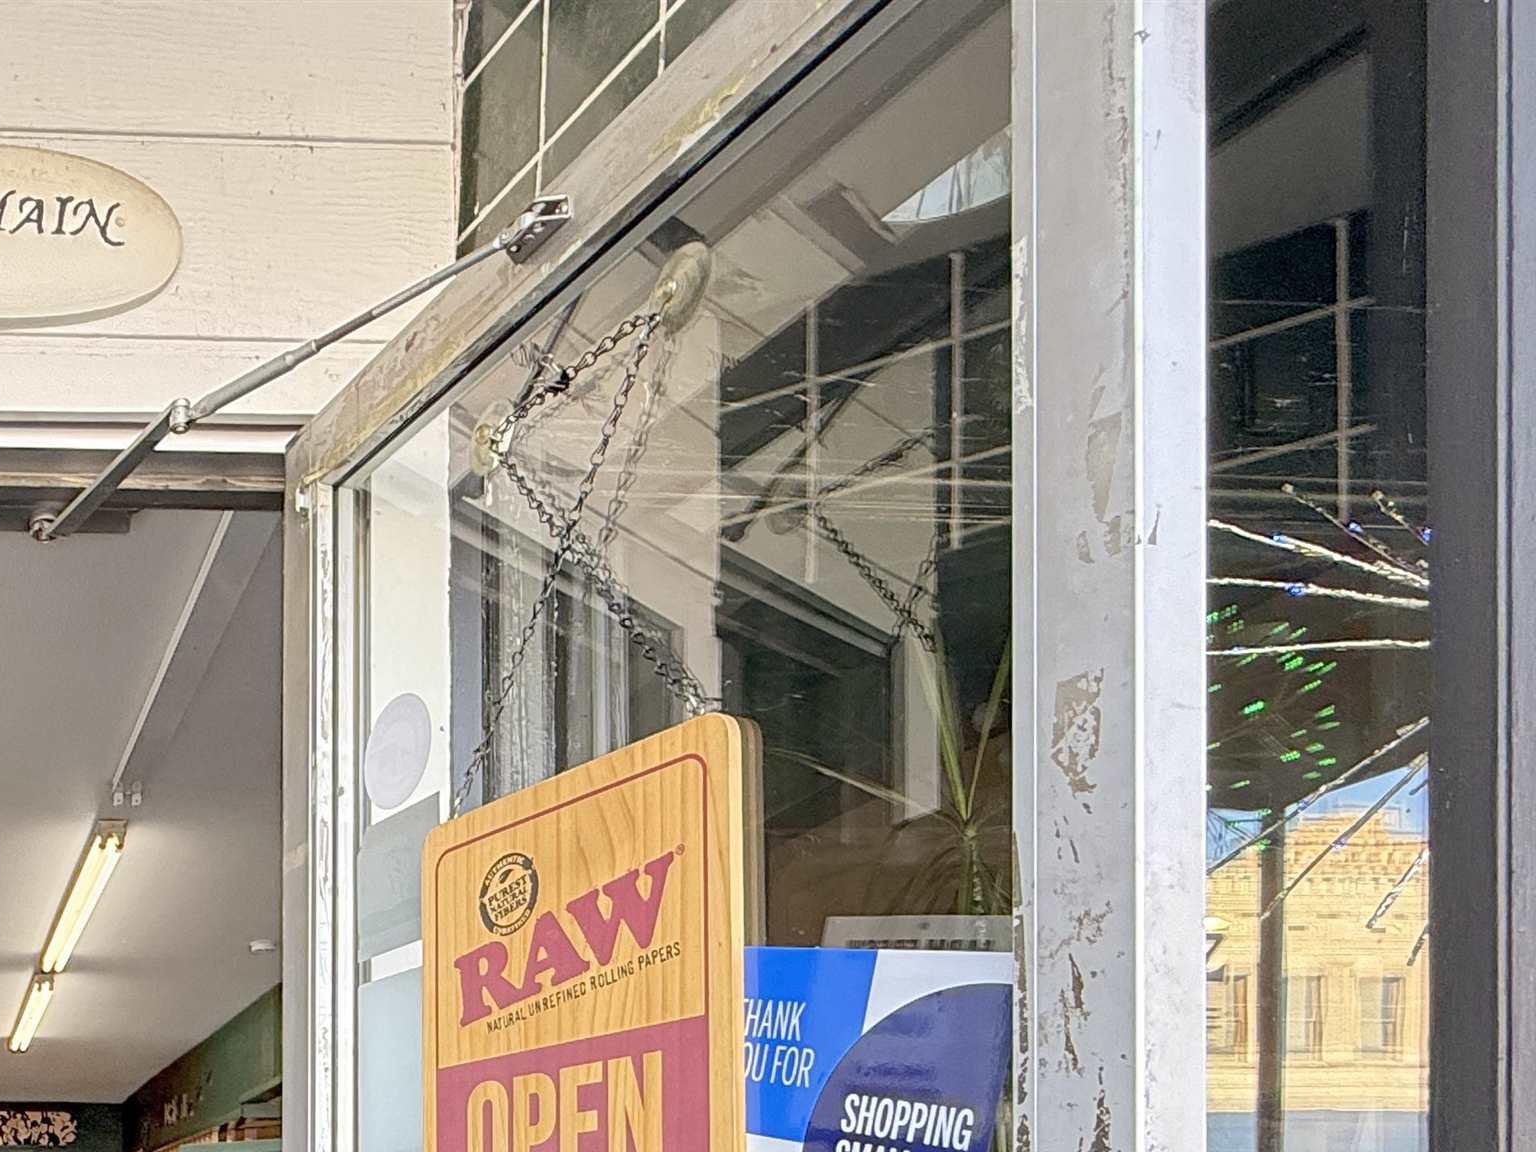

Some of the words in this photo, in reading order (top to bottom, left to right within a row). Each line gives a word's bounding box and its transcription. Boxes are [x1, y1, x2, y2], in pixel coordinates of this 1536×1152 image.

[488, 874, 527, 906] PUREST
[490, 887, 527, 913] NATURAL
[494, 897, 527, 921] FIBERS
[454, 850, 674, 1028] RAW
[487, 1012, 527, 1033] NATURAL
[528, 982, 586, 1017] UNREFINED
[590, 960, 634, 991] ROLLING
[638, 941, 681, 970] PAPERS
[744, 998, 806, 1041] HANK
[744, 1041, 769, 1082] OU
[770, 1045, 815, 1088] FOR
[840, 1092, 975, 1152] SHOPPING
